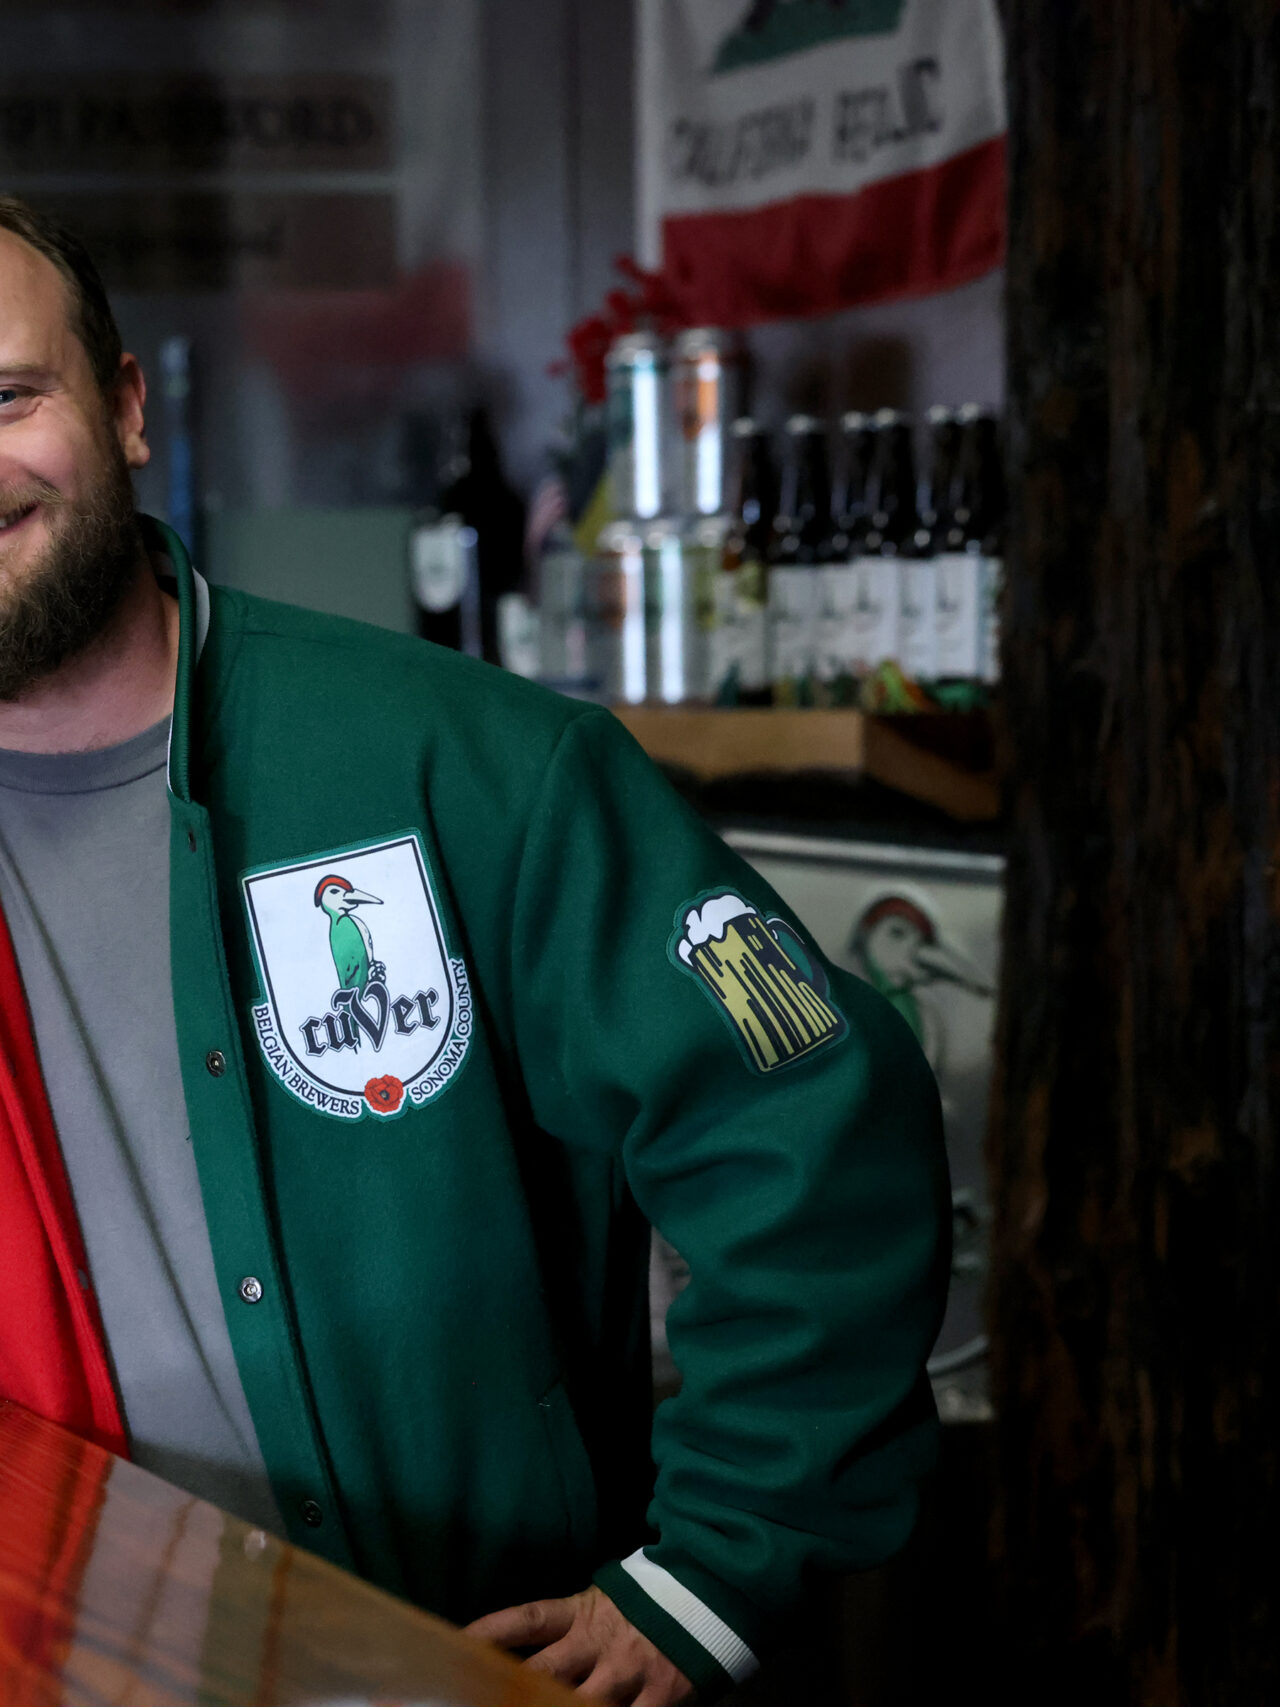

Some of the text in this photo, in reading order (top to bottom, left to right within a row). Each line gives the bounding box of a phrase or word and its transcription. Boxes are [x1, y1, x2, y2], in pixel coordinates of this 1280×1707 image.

[254, 1006, 360, 1115] BELGIAN BREWERS
[411, 959, 472, 1101] SONOMA COUNTY
